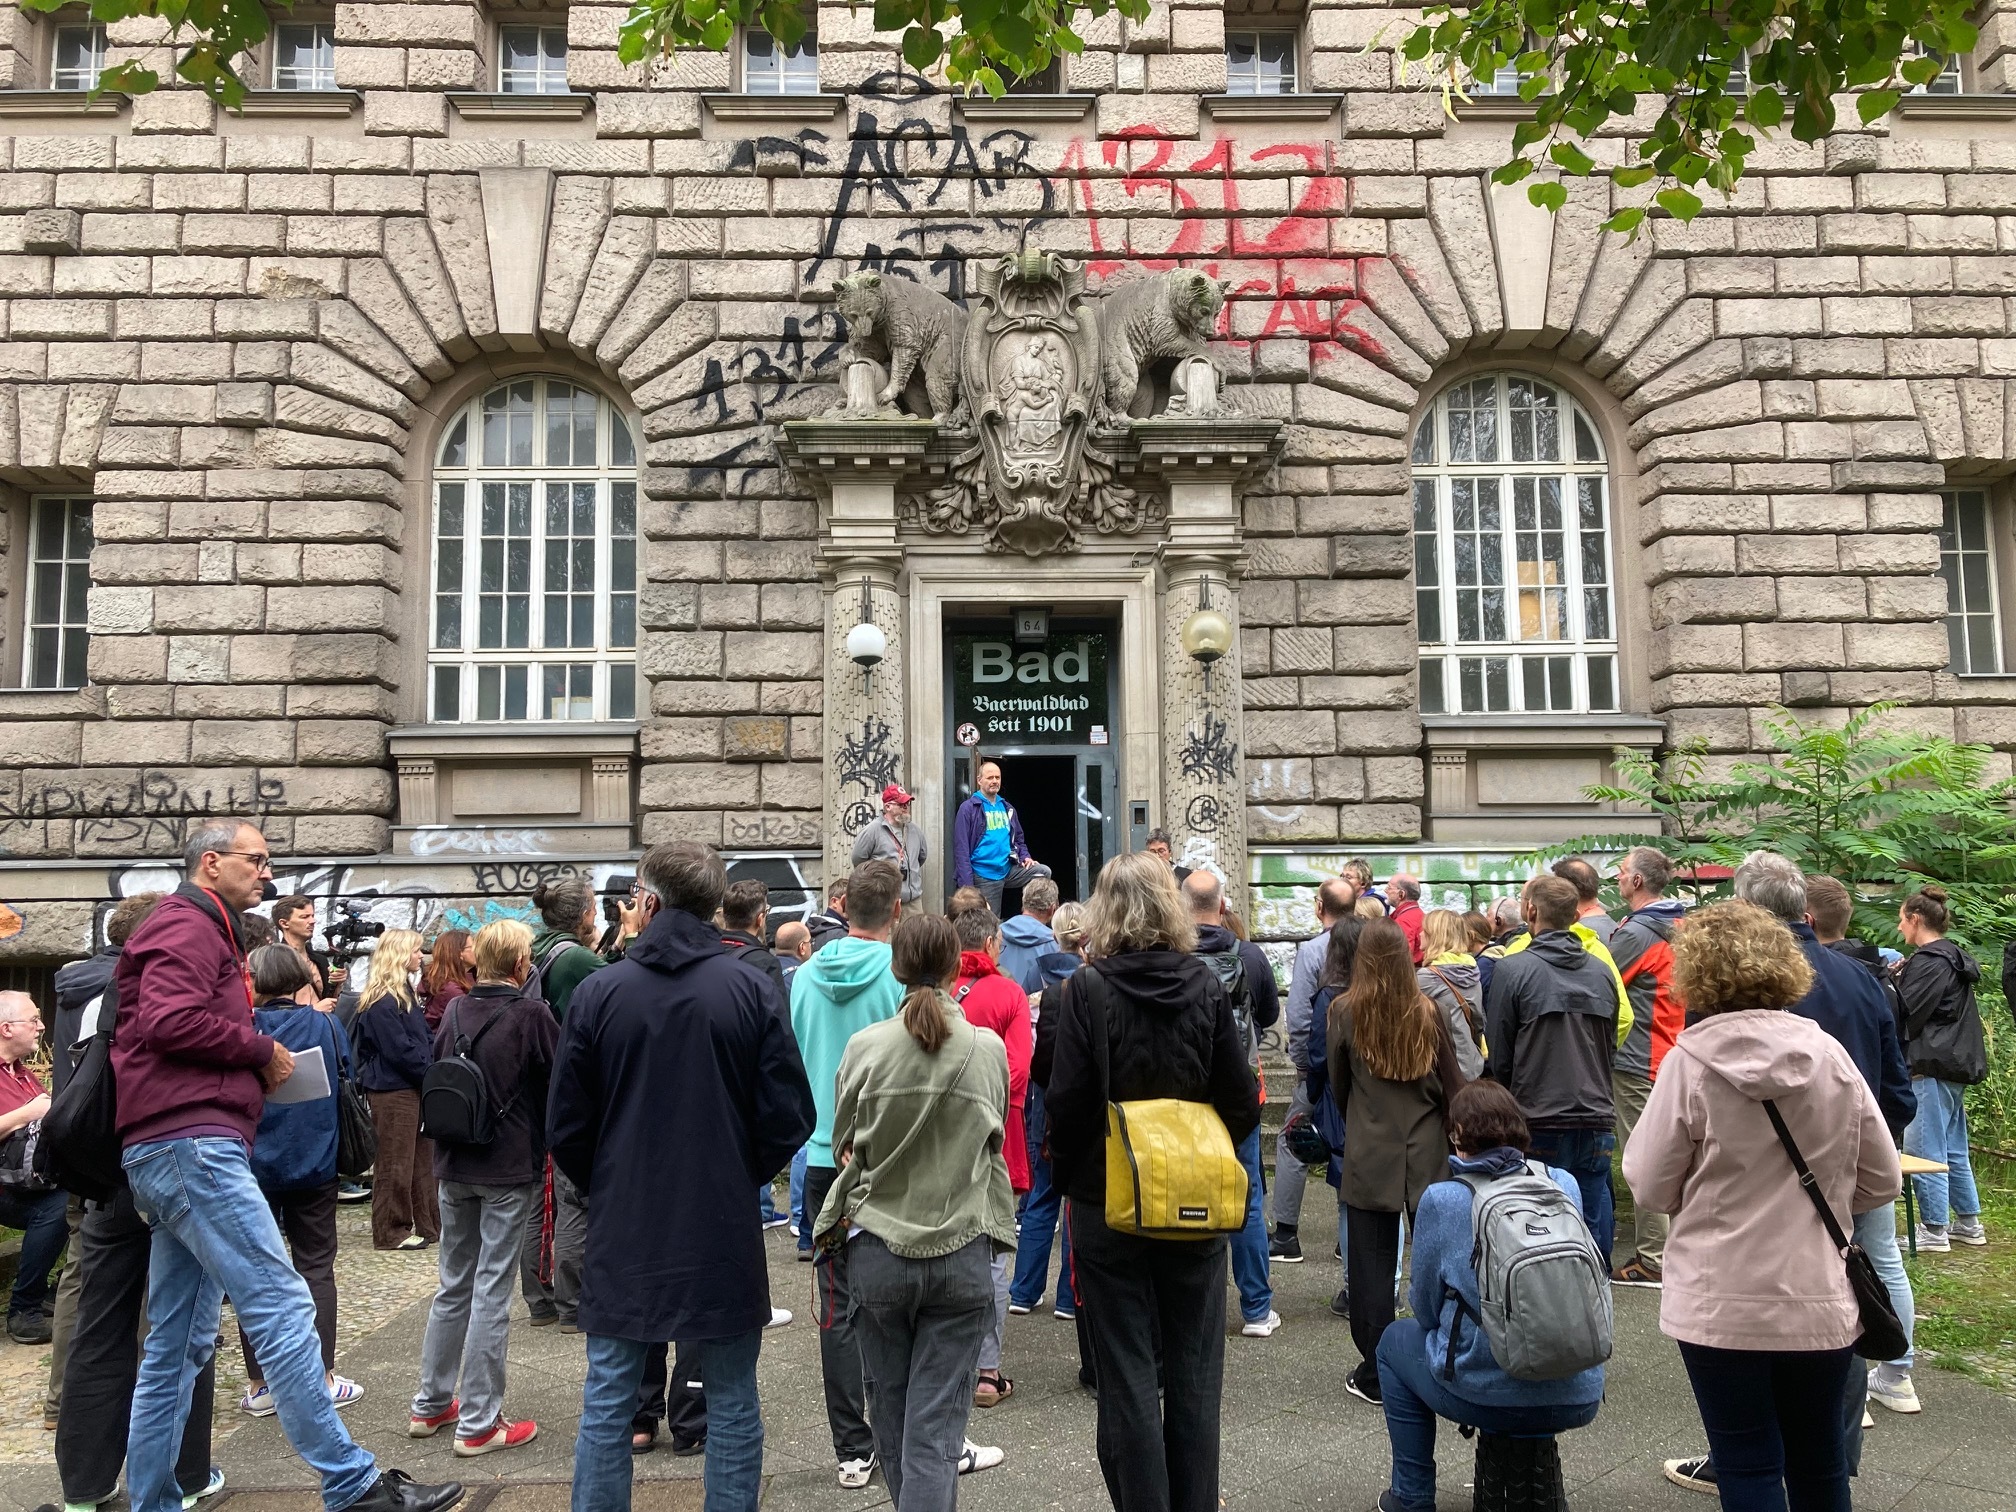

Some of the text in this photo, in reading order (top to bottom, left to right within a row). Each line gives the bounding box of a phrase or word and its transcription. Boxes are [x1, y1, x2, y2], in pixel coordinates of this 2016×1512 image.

[804, 111, 1347, 286] ACAB 1312
[693, 311, 848, 424] 1312
[1024, 620, 1040, 631] 64
[972, 641, 1089, 683] Bad
[972, 693, 1090, 712] Baerwaldbad
[988, 714, 1074, 732] seit 1901
